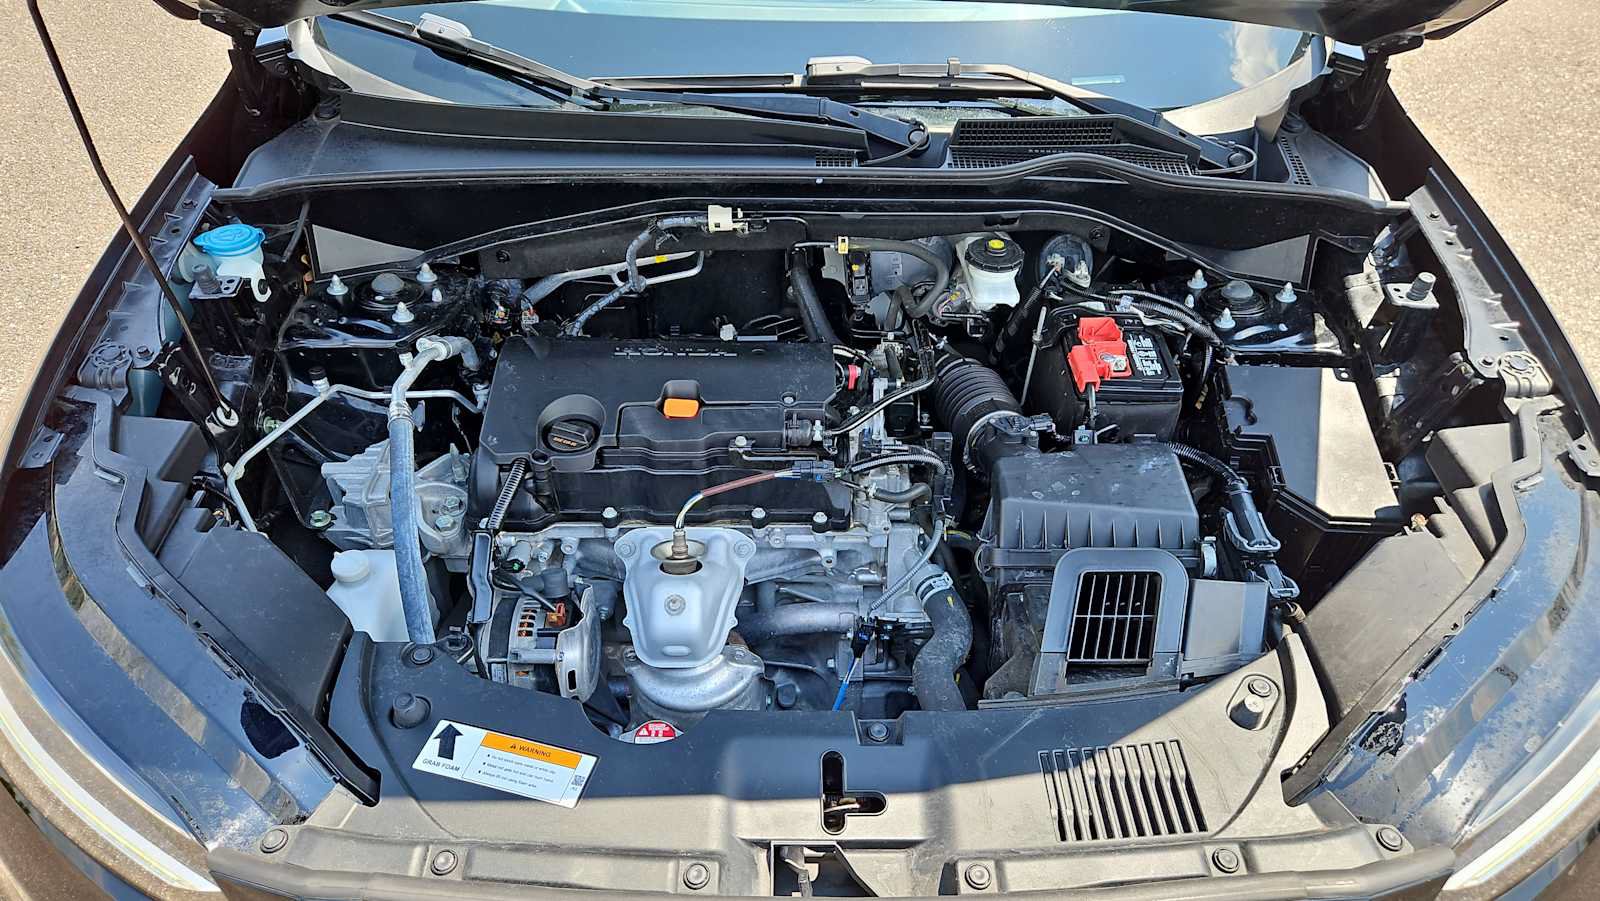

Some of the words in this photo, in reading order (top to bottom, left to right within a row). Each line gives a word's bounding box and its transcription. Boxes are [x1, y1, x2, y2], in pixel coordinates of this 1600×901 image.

[518, 744, 552, 758] WARNING
[422, 758, 442, 769] GRAB
[441, 762, 461, 773] FOAM
